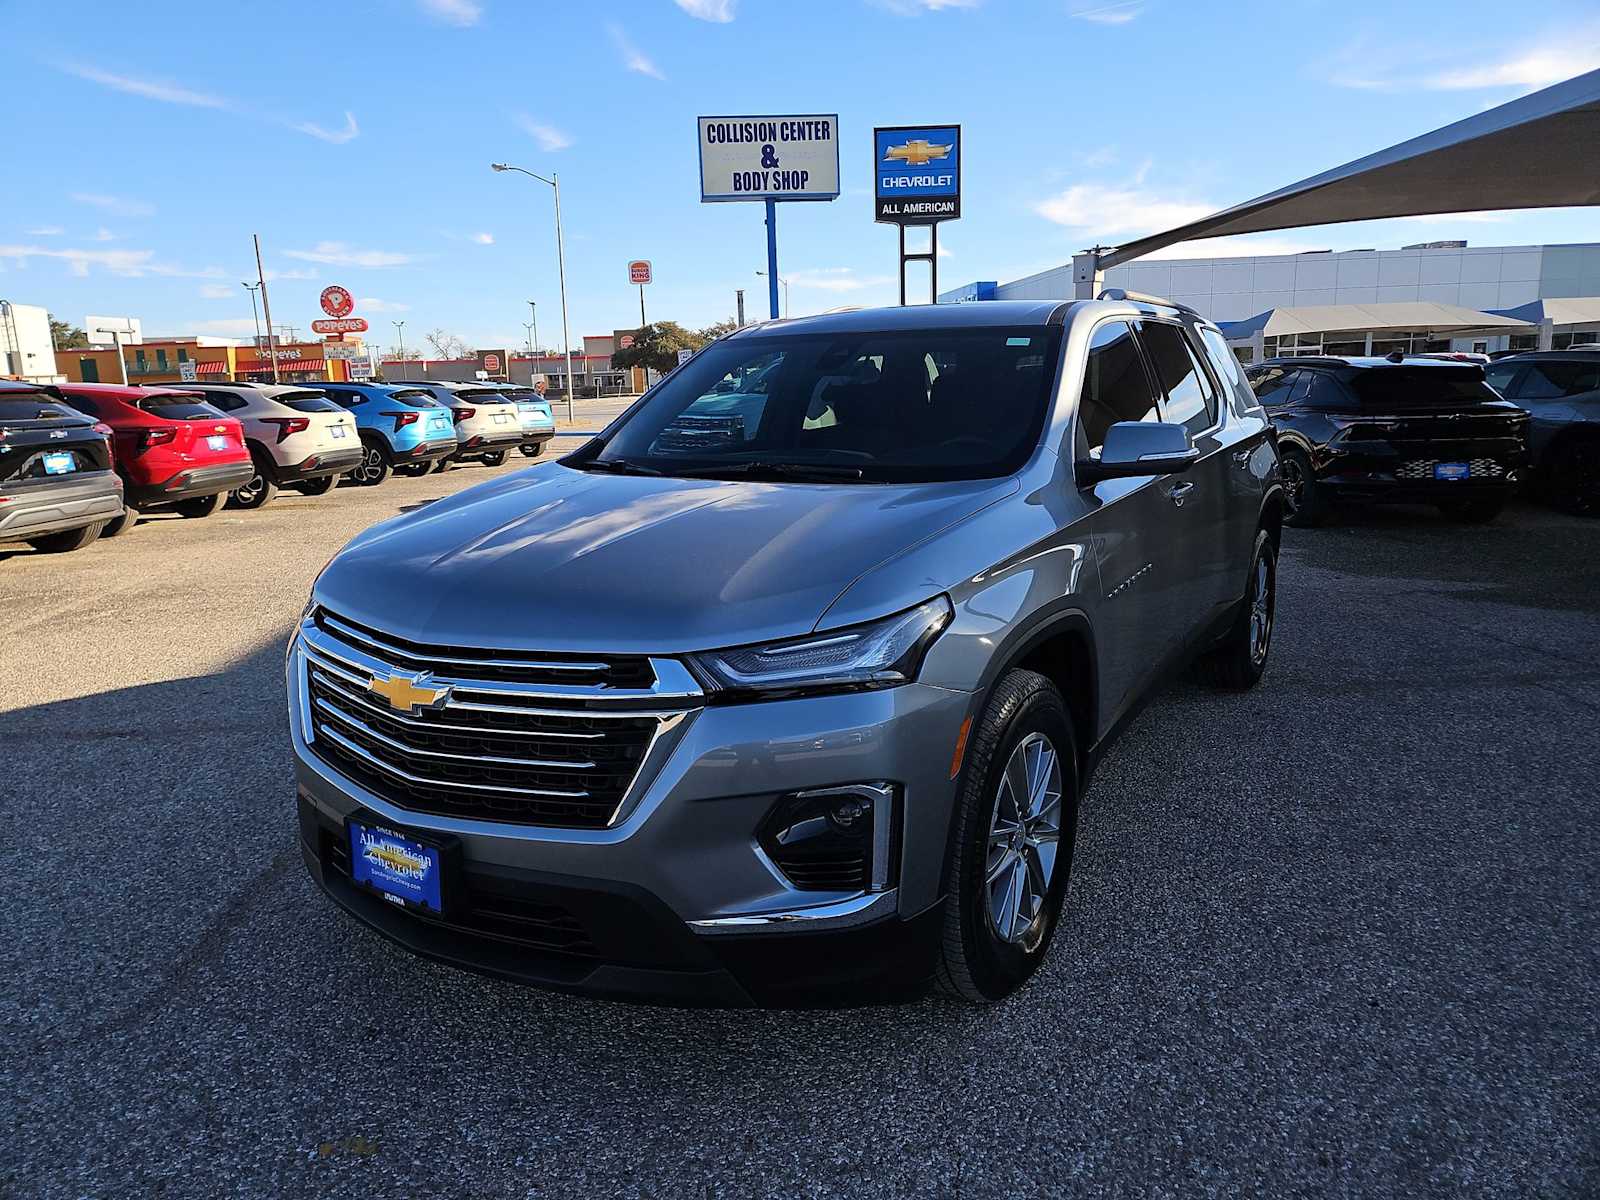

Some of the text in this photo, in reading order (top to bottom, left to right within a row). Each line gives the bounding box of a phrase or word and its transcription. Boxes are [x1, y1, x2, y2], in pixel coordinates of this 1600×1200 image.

[707, 121, 830, 143] COLLISION CENTER
[761, 144, 779, 168] &
[733, 170, 808, 191] BODY SHOP
[882, 175, 952, 188] CHEVROLET
[882, 202, 954, 214] ALL AMERICAN
[360, 833, 432, 867] All American
[369, 851, 425, 880] Chevrolet
